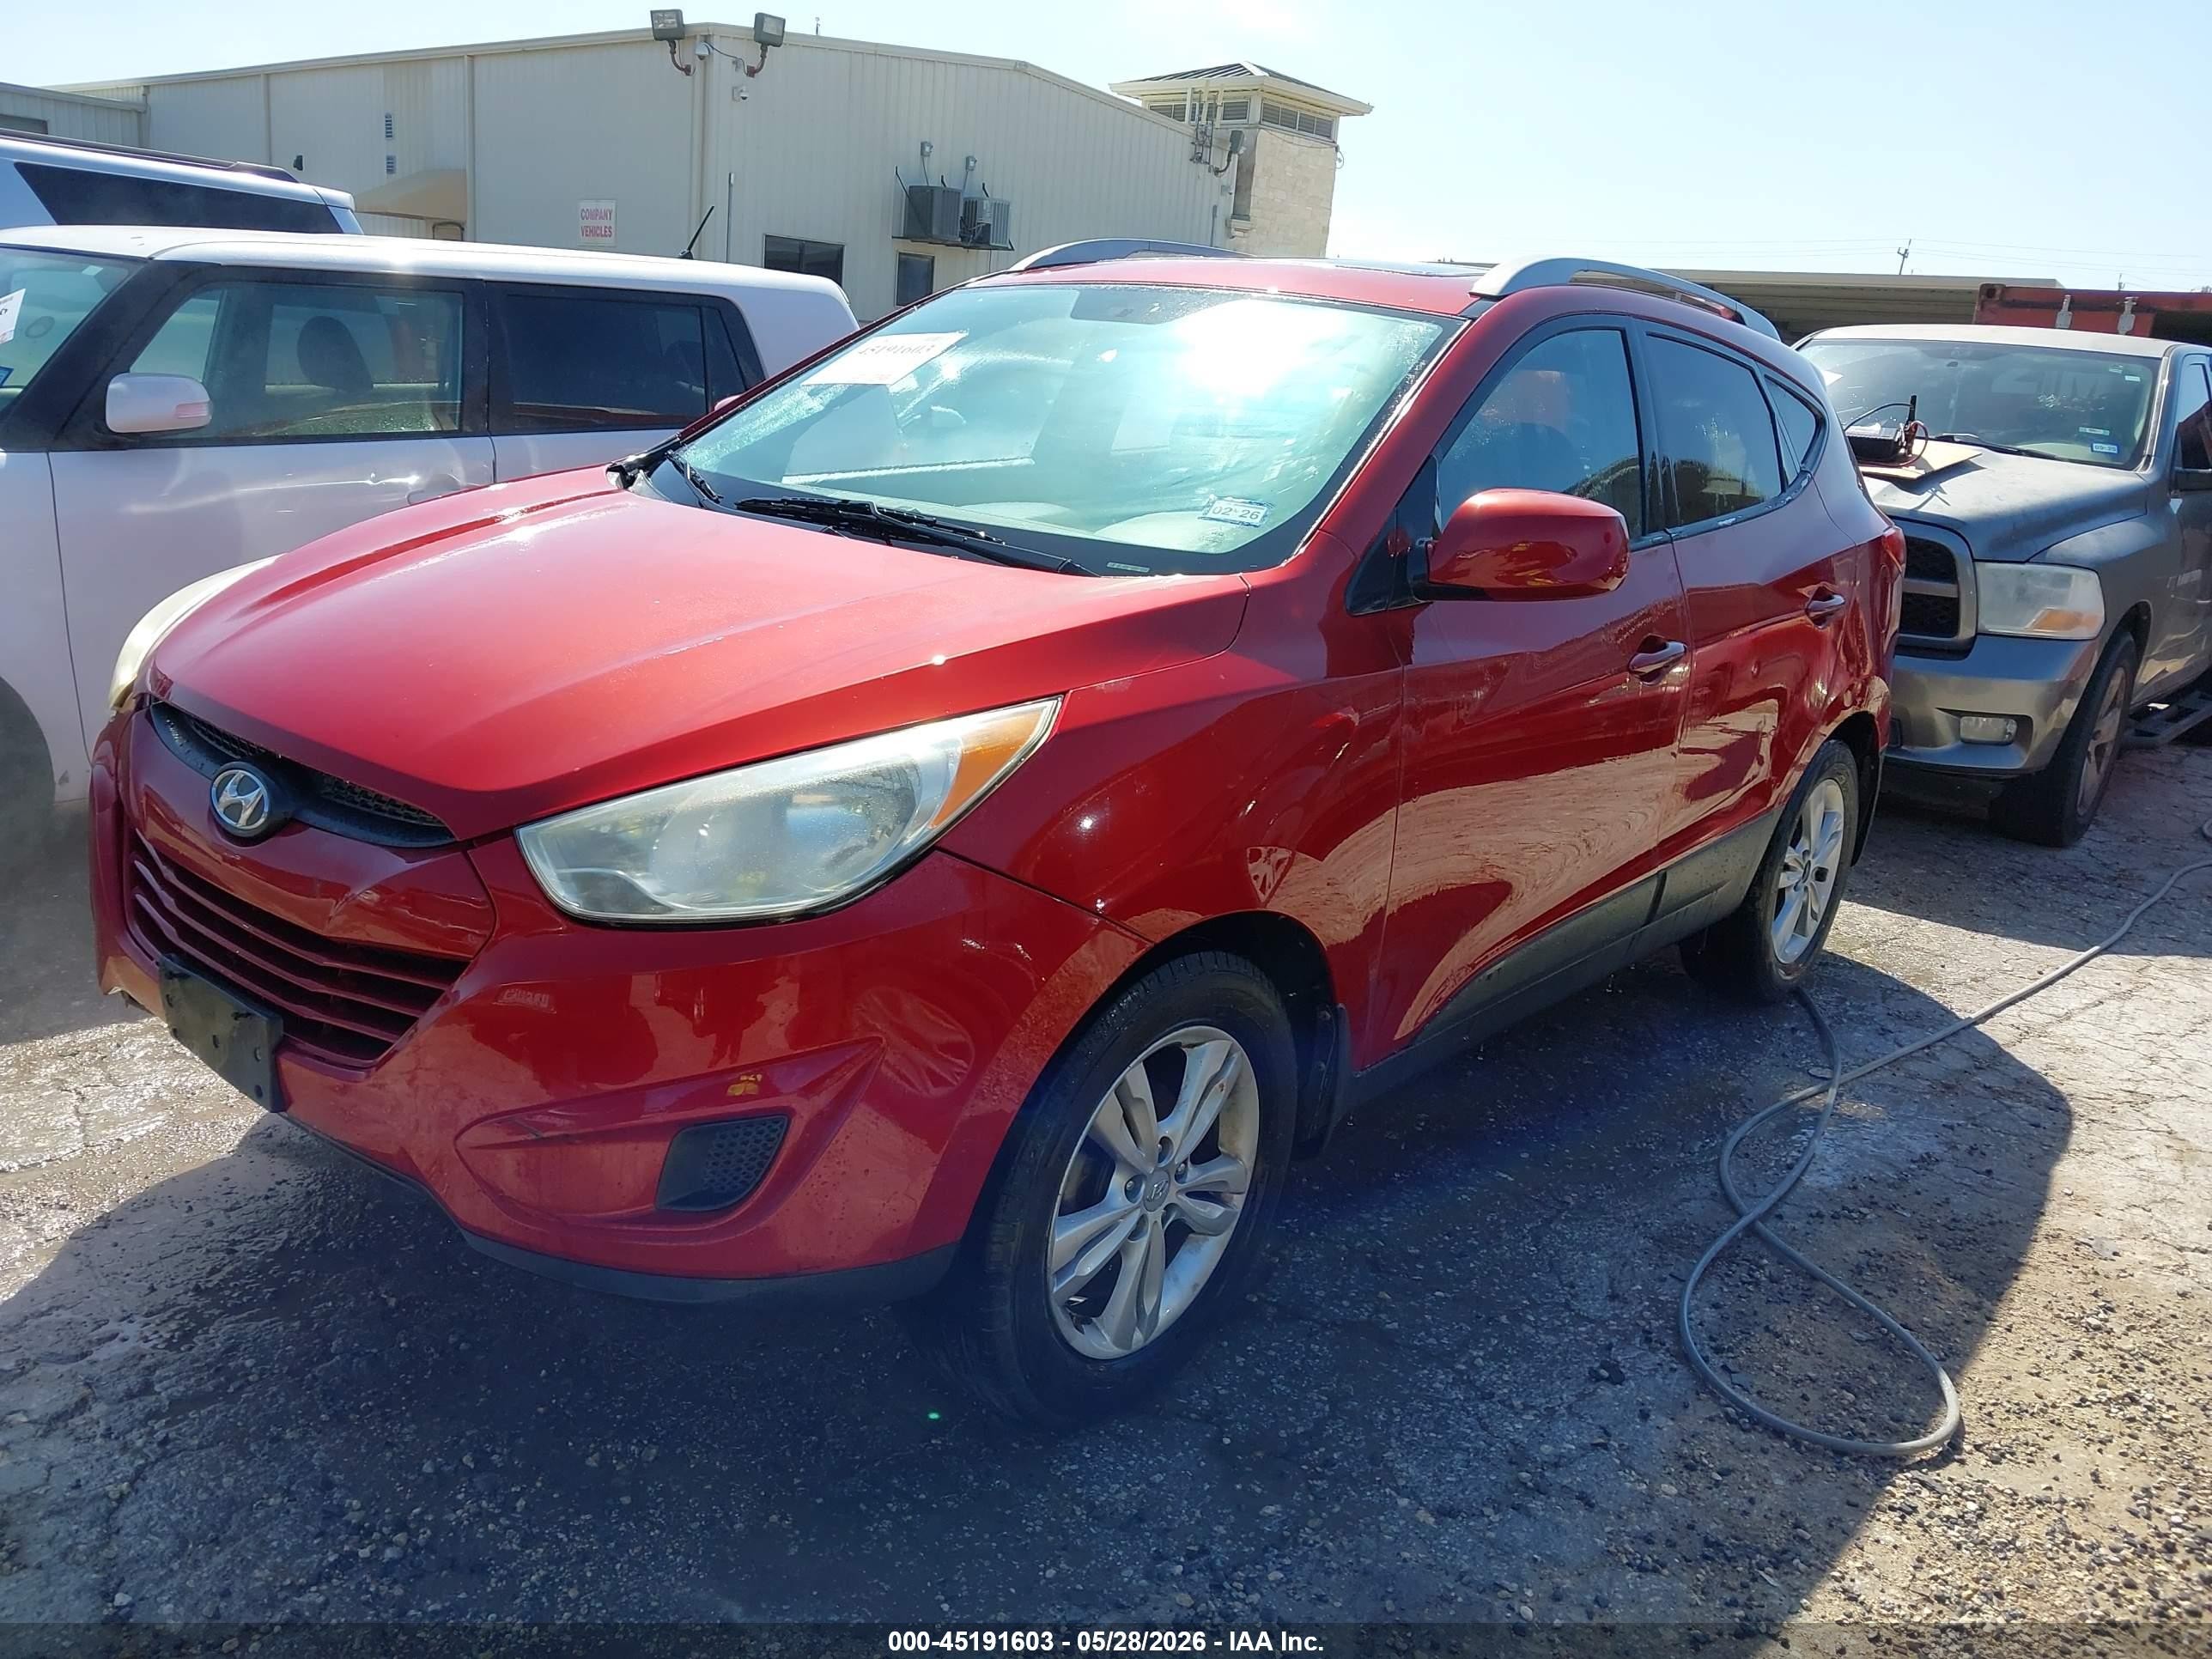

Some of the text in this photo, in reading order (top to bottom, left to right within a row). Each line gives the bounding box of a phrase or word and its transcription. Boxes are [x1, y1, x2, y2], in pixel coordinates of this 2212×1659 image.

[580, 209, 612, 220] COMPANY
[580, 226, 612, 237] VEHICLES
[1239, 509, 1261, 520] 26
